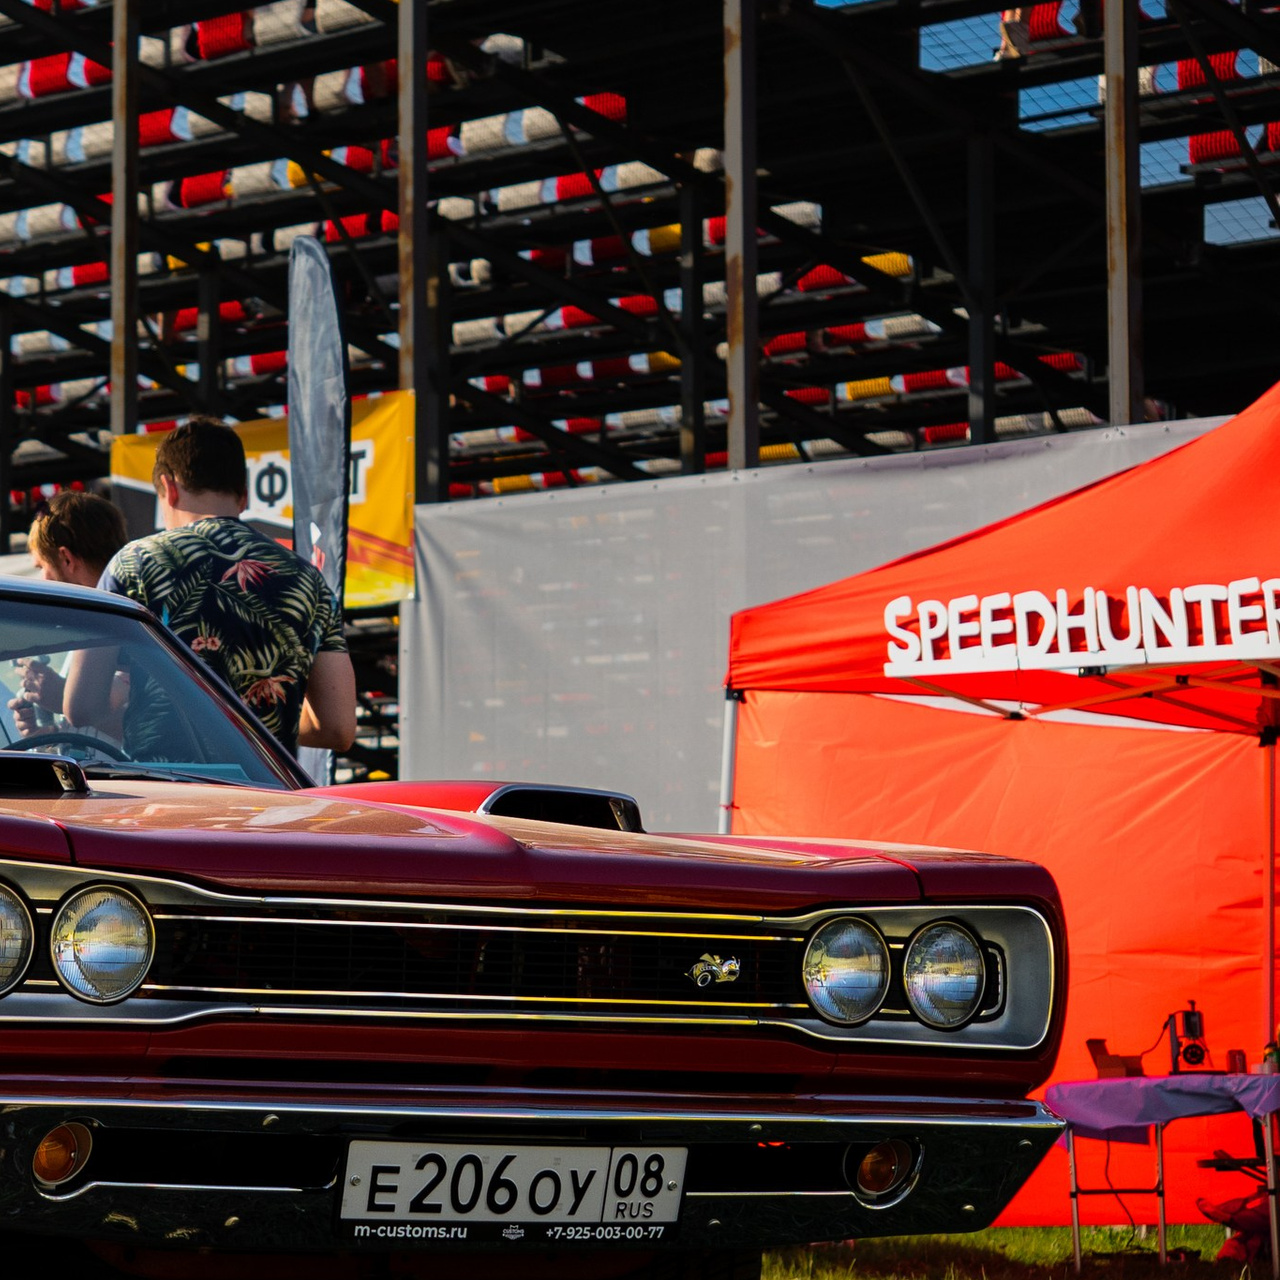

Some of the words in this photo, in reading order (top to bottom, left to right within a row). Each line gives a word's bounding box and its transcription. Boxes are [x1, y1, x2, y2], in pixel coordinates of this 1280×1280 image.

[613, 1152, 665, 1199] 08
[615, 1202, 654, 1220] RUS
[354, 1224, 468, 1238] m-customs.ru
[546, 1226, 665, 1240] +7-925-003-00-77
